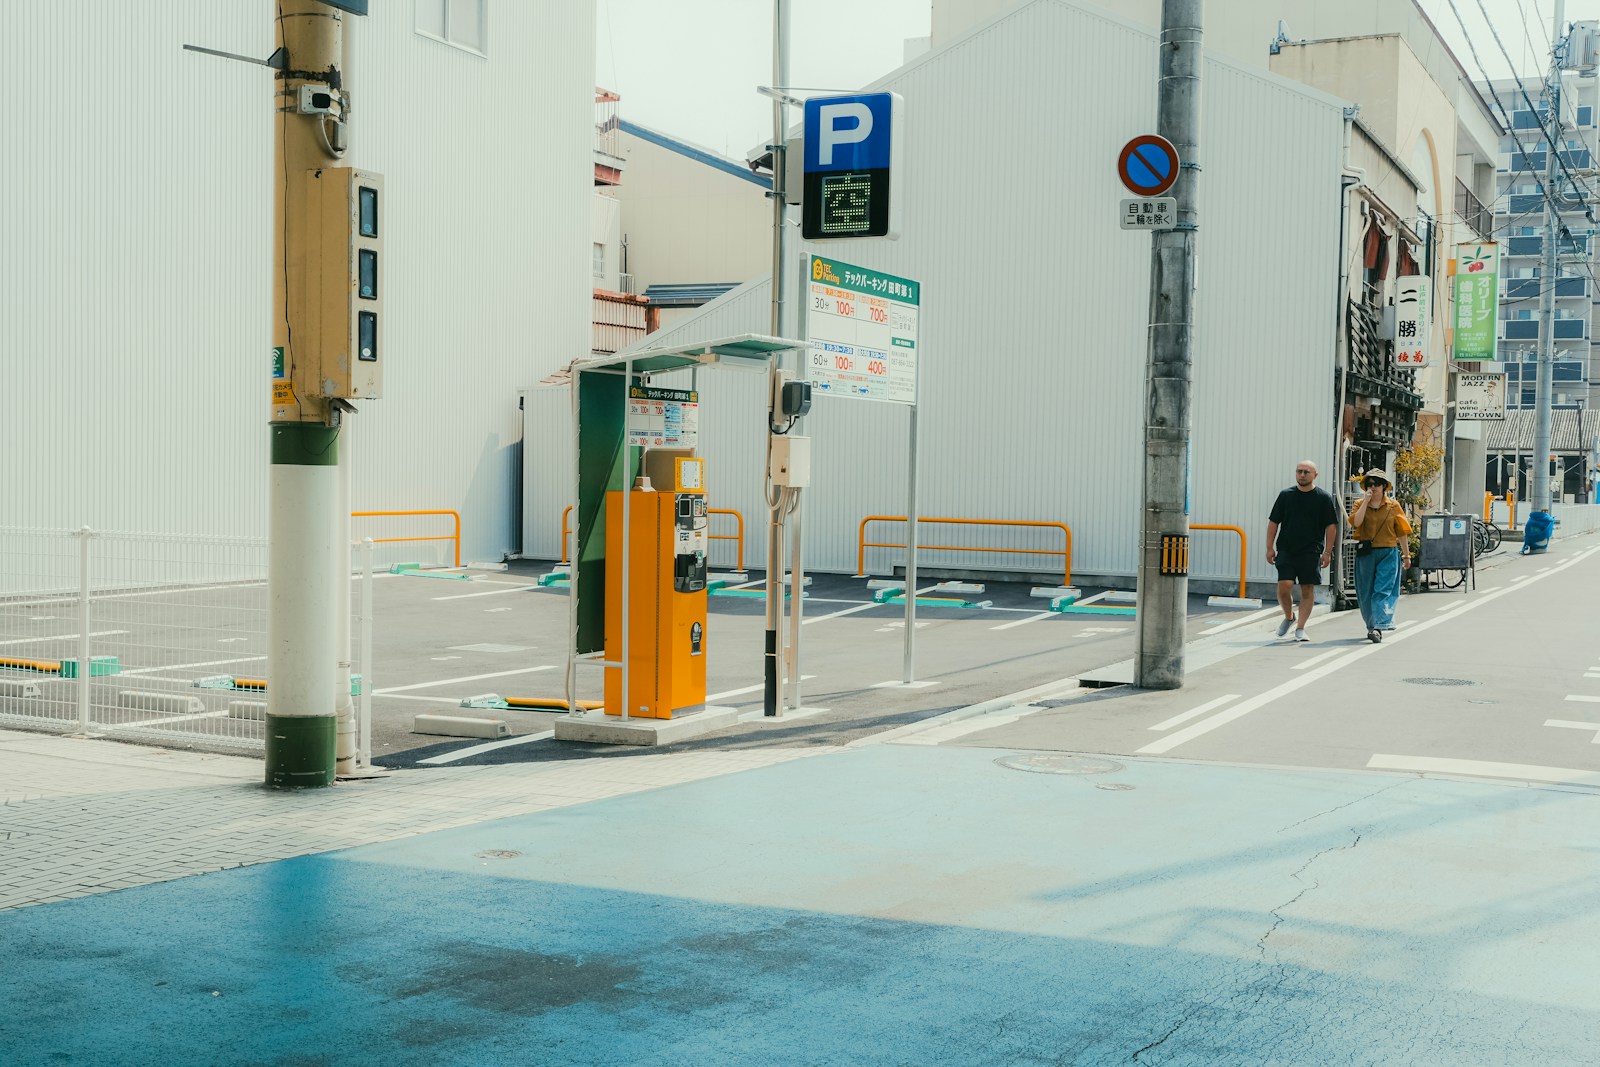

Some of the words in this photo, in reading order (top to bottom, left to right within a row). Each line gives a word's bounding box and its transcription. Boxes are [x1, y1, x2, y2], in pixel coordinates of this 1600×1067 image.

[819, 102, 874, 165] P
[1129, 202, 1167, 214] 自動車
[823, 263, 832, 274] TEC
[823, 271, 840, 285] Parking
[844, 270, 887, 292] テックパーキング
[1458, 280, 1474, 329] 歯科医院
[1476, 275, 1492, 321] オリーブ
[836, 300, 855, 317] 100円
[869, 307, 888, 323] 700円
[834, 355, 854, 371] 100円
[867, 360, 887, 376] 400円
